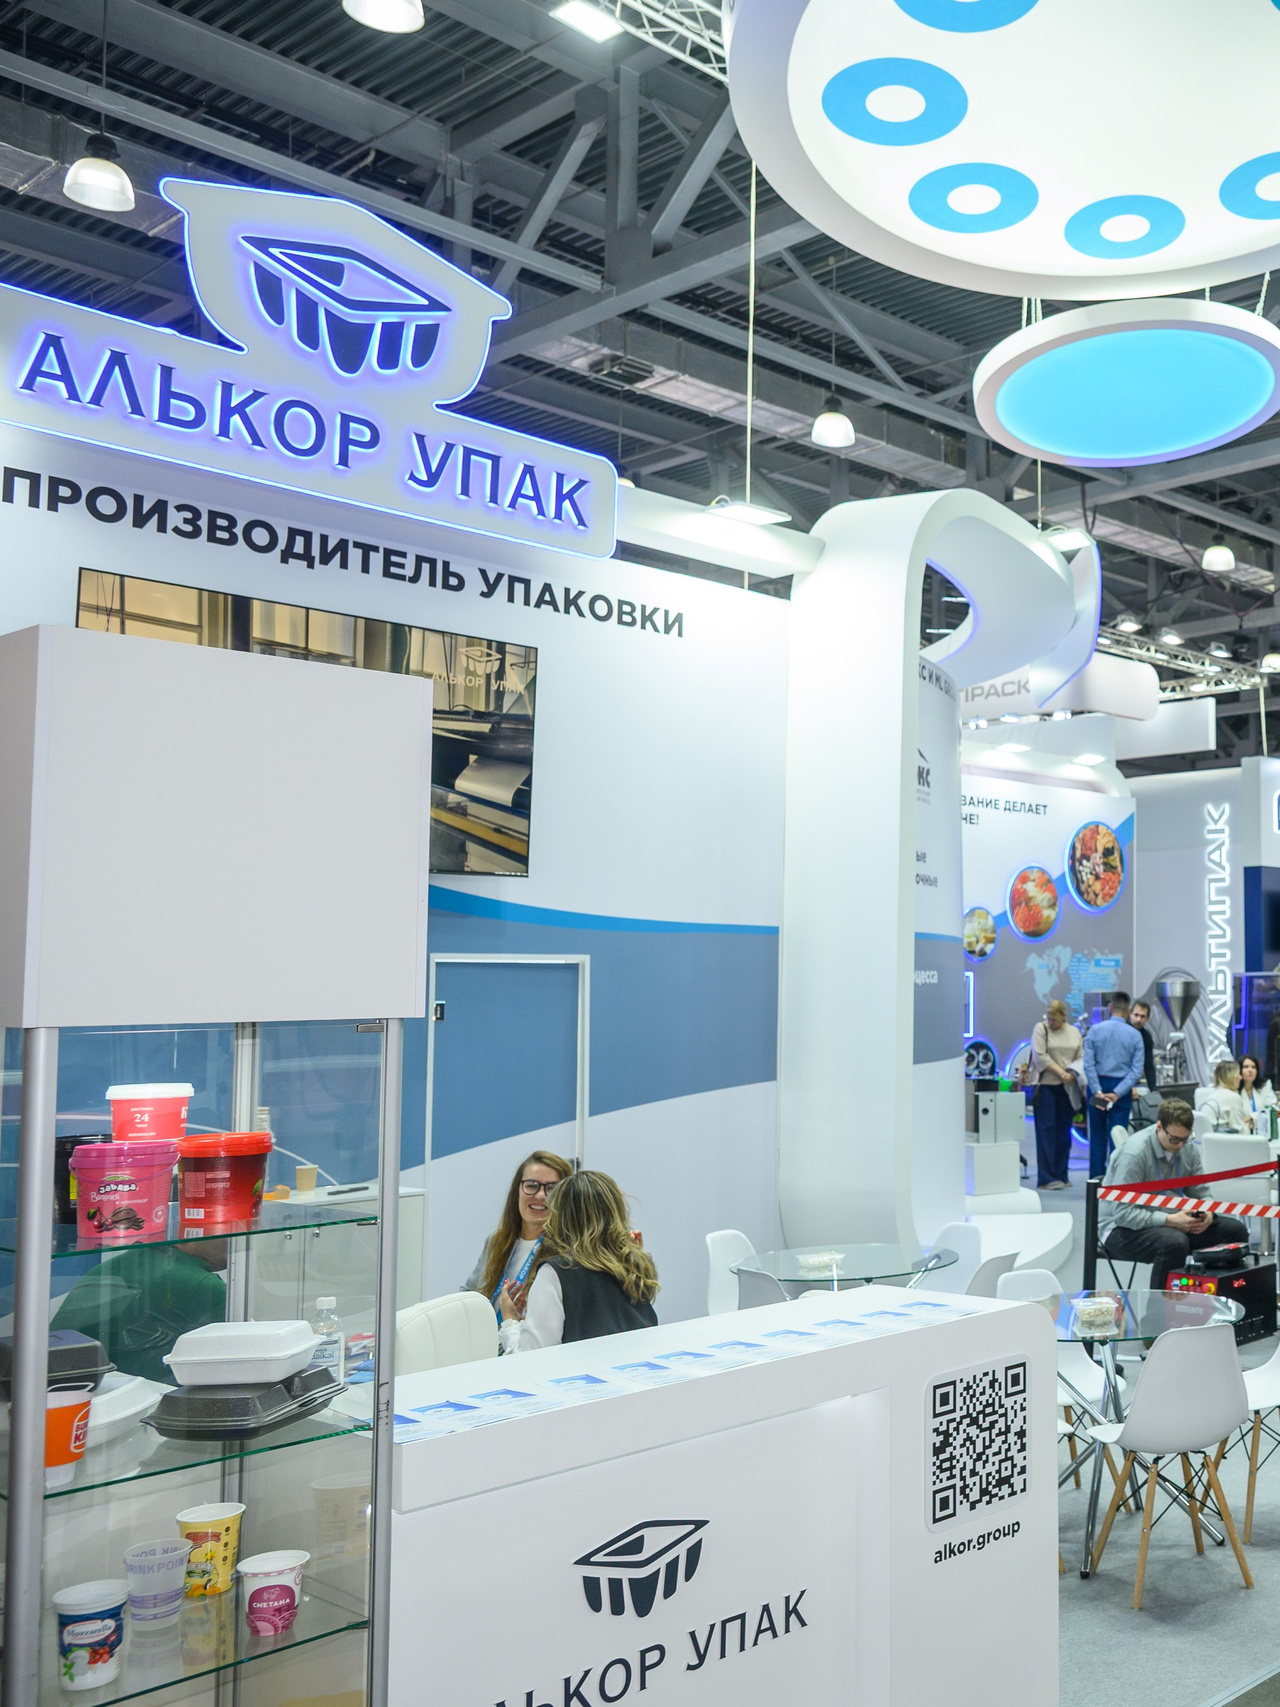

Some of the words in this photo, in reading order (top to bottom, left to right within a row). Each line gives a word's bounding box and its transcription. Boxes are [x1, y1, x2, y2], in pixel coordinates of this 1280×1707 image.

[19, 331, 381, 470] АЛЬКОР
[406, 431, 591, 530] УПАК
[2, 466, 467, 593] ПРОИЗВОДИТЕЛЬ
[477, 567, 686, 638] УПАКОВКИ
[432, 672, 484, 688] АЛЬКОР
[917, 765, 930, 788] КС
[961, 795, 1000, 810] ВАНИЕ
[1004, 800, 1048, 815] ДЕЛАЕТ
[915, 873, 938, 887] очные
[1205, 802, 1231, 1064] УЛЬТИПАК
[915, 969, 938, 986] цесса
[134, 1113, 149, 1123] 24
[934, 1521, 1021, 1564] alkor.group
[157, 1554, 187, 1574] POIN
[252, 1598, 291, 1609] СМЕТАНА
[686, 1588, 809, 1672] УПАК
